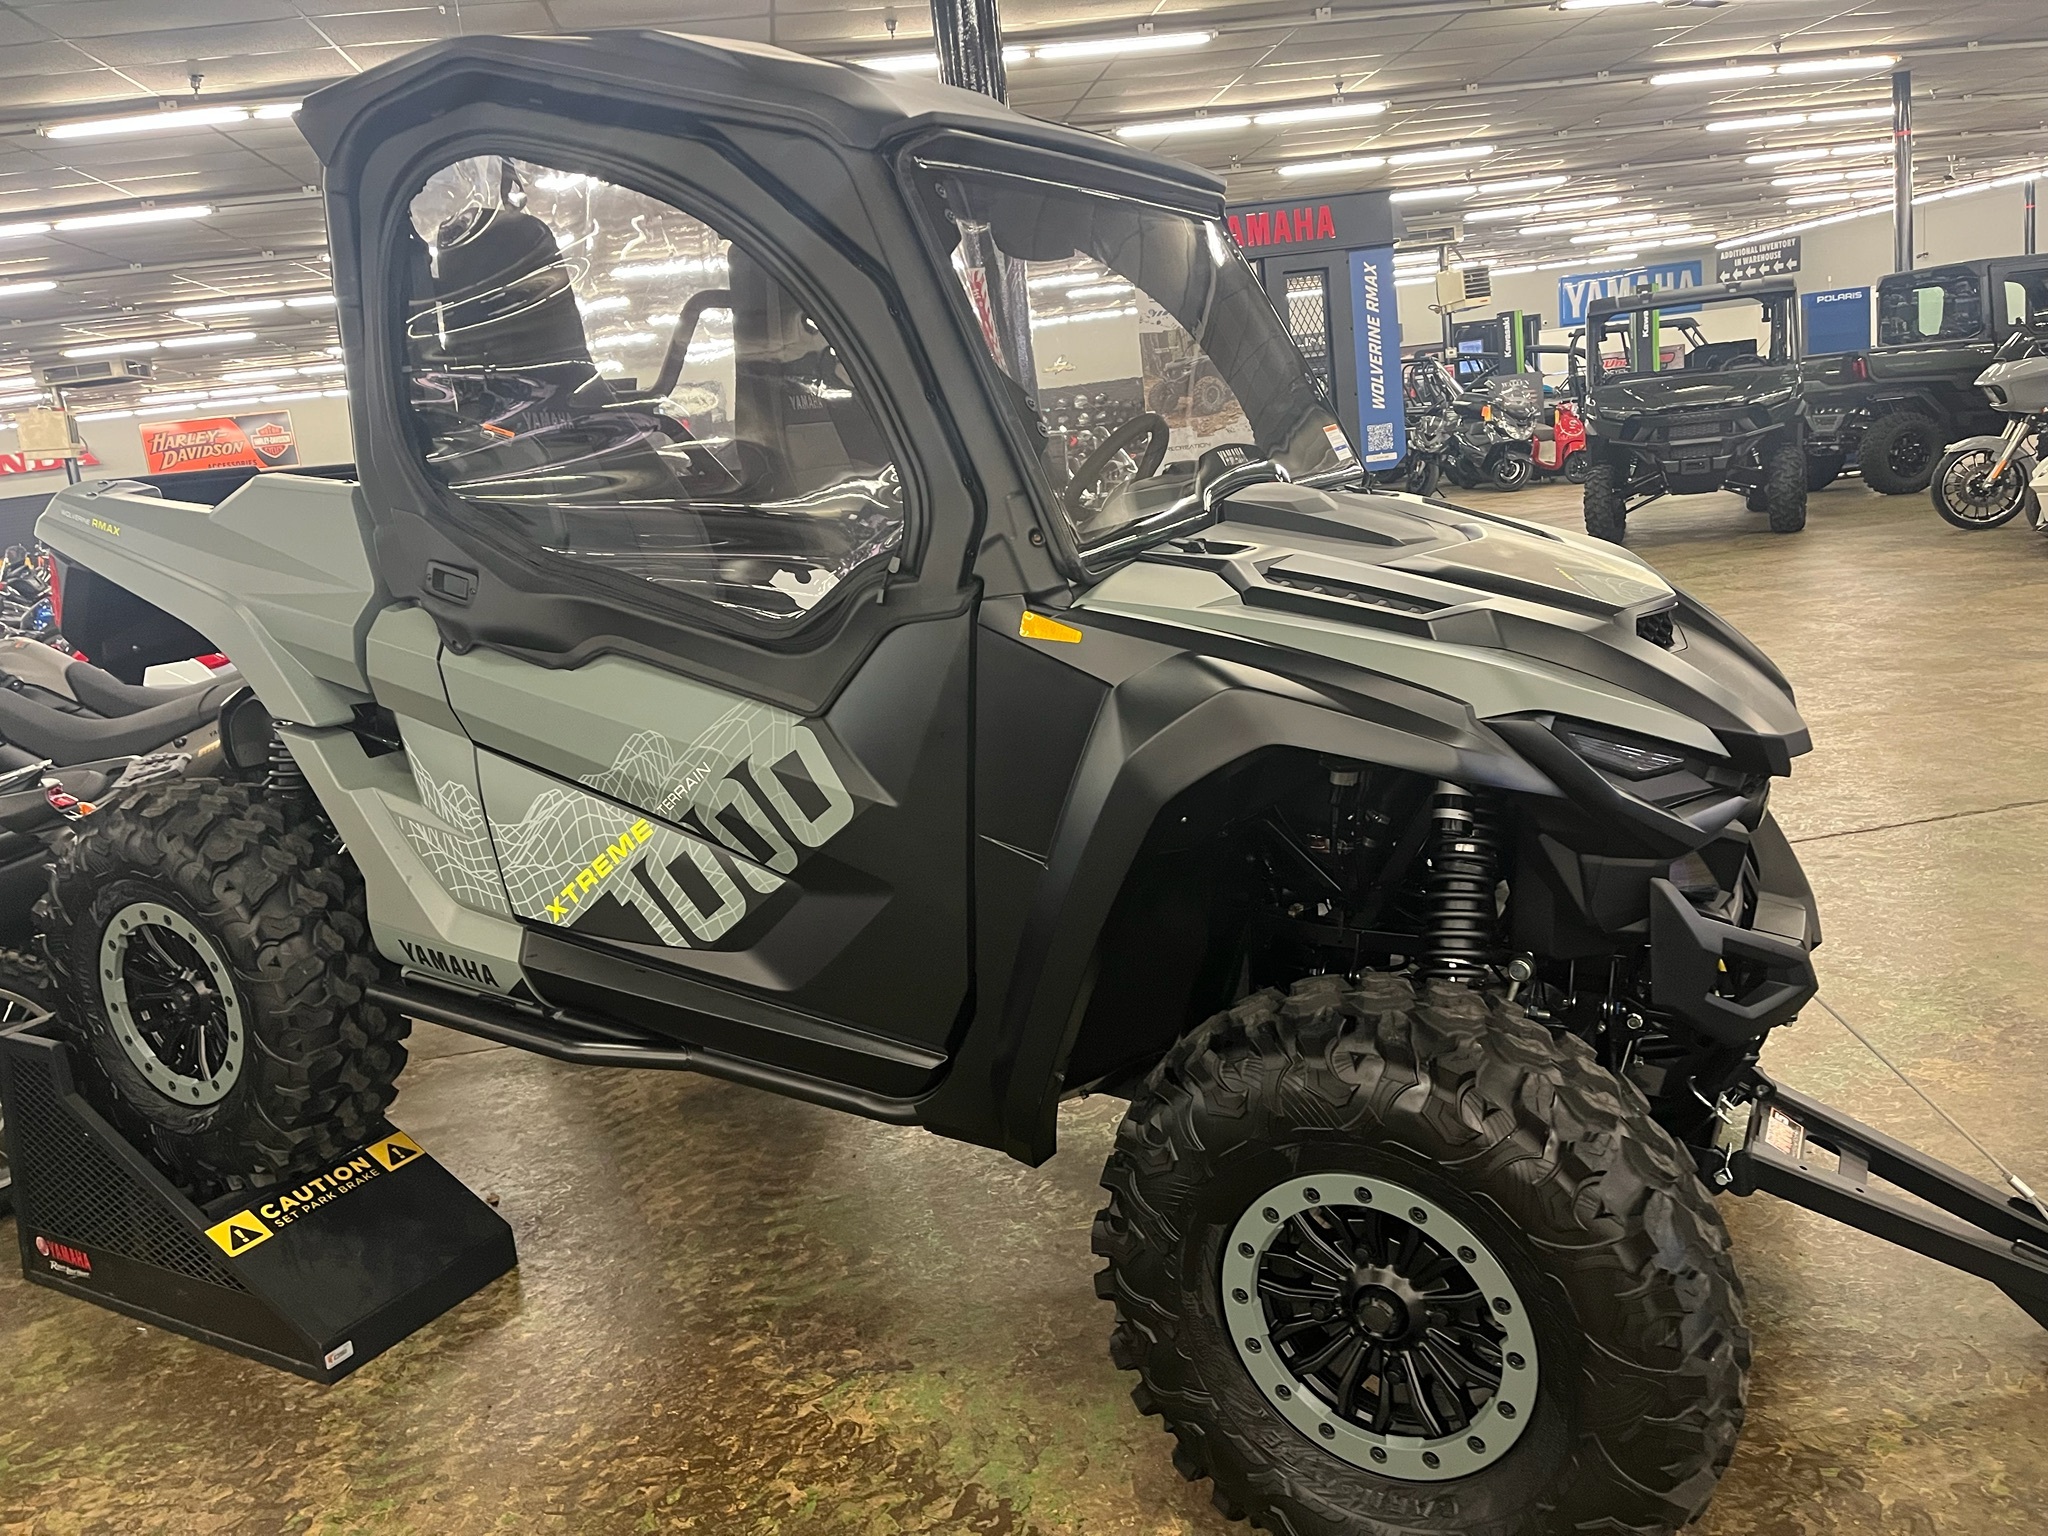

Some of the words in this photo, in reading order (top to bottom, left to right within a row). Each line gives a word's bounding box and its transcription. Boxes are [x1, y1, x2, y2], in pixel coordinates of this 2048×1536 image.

[1228, 204, 1336, 247] AMAHA
[1721, 247, 1758, 260] ADDITIONAL
[1759, 238, 1796, 251] INVENTORY
[1734, 258, 1742, 266] IN
[1743, 251, 1782, 265] WAREHOUSE
[1363, 261, 1380, 313] RMAX
[1562, 269, 1694, 318] YAMHA
[1816, 291, 1862, 304] POLARIS
[1502, 316, 1512, 358] Kawasaki
[1367, 315, 1386, 410] WOLVERINE
[521, 411, 575, 430] YAMAHA
[159, 441, 243, 471] DAVIDSON
[61, 509, 90, 526] WOLVERINE
[91, 518, 120, 536] RMAX
[545, 818, 654, 923] XTREME
[657, 762, 712, 815] TERRAIN
[616, 726, 854, 948] 1000
[398, 939, 500, 988] YAMAHA
[260, 1156, 372, 1219] CAUTION
[274, 1210, 299, 1228] SET
[301, 1192, 337, 1213] PARK
[338, 1168, 380, 1194] BRAKE
